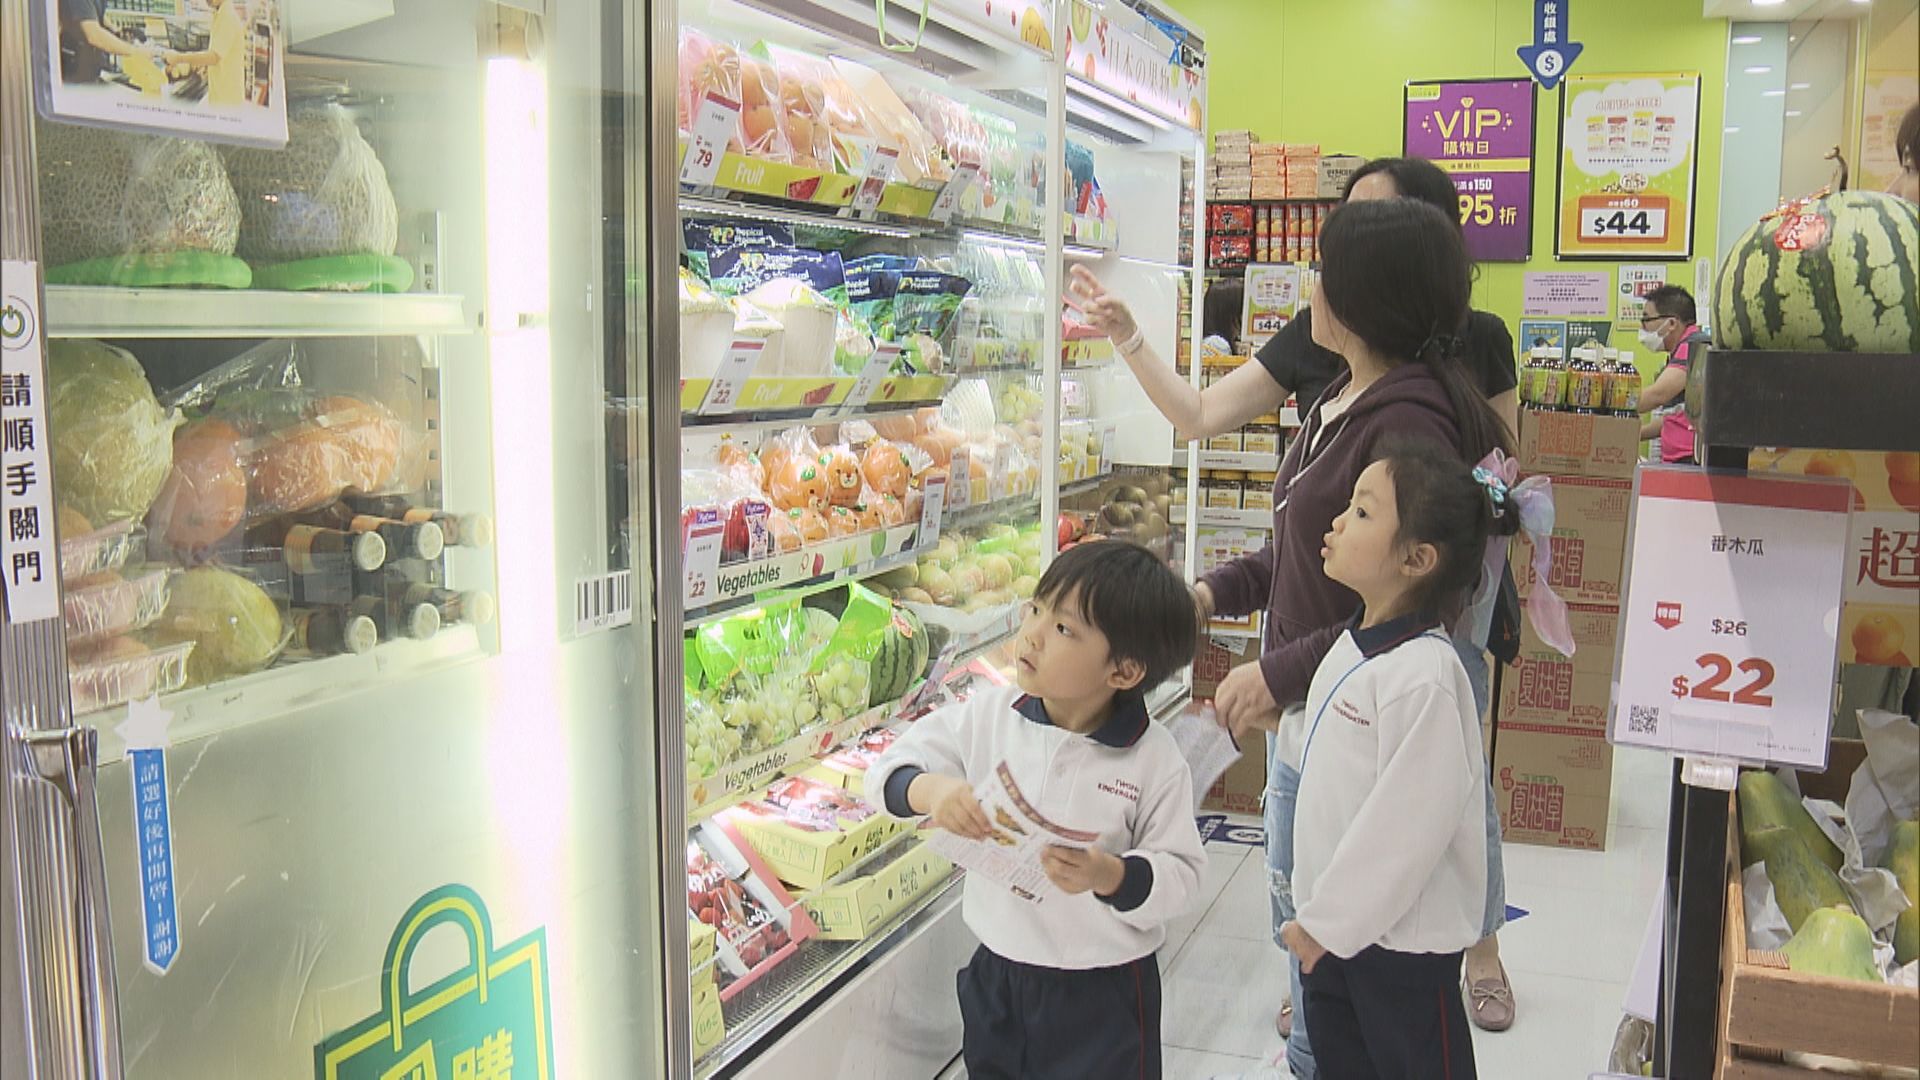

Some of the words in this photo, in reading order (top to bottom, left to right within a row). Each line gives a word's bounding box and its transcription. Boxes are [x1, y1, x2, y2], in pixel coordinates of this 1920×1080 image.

[1433, 99, 1501, 139] VIP
[735, 161, 765, 186] Fruit
[1594, 211, 1651, 235] $44
[753, 383, 785, 401] Fruit
[1, 373, 41, 586] 請順手關門
[1711, 535, 1764, 556] 番木瓜
[717, 564, 781, 596] Vegetables
[1711, 618, 1748, 636] $26
[1519, 659, 1573, 711] 夏枯草
[1671, 652, 1775, 708] $22
[725, 751, 788, 790] Vegetables
[1510, 781, 1564, 833] 夏枯草
